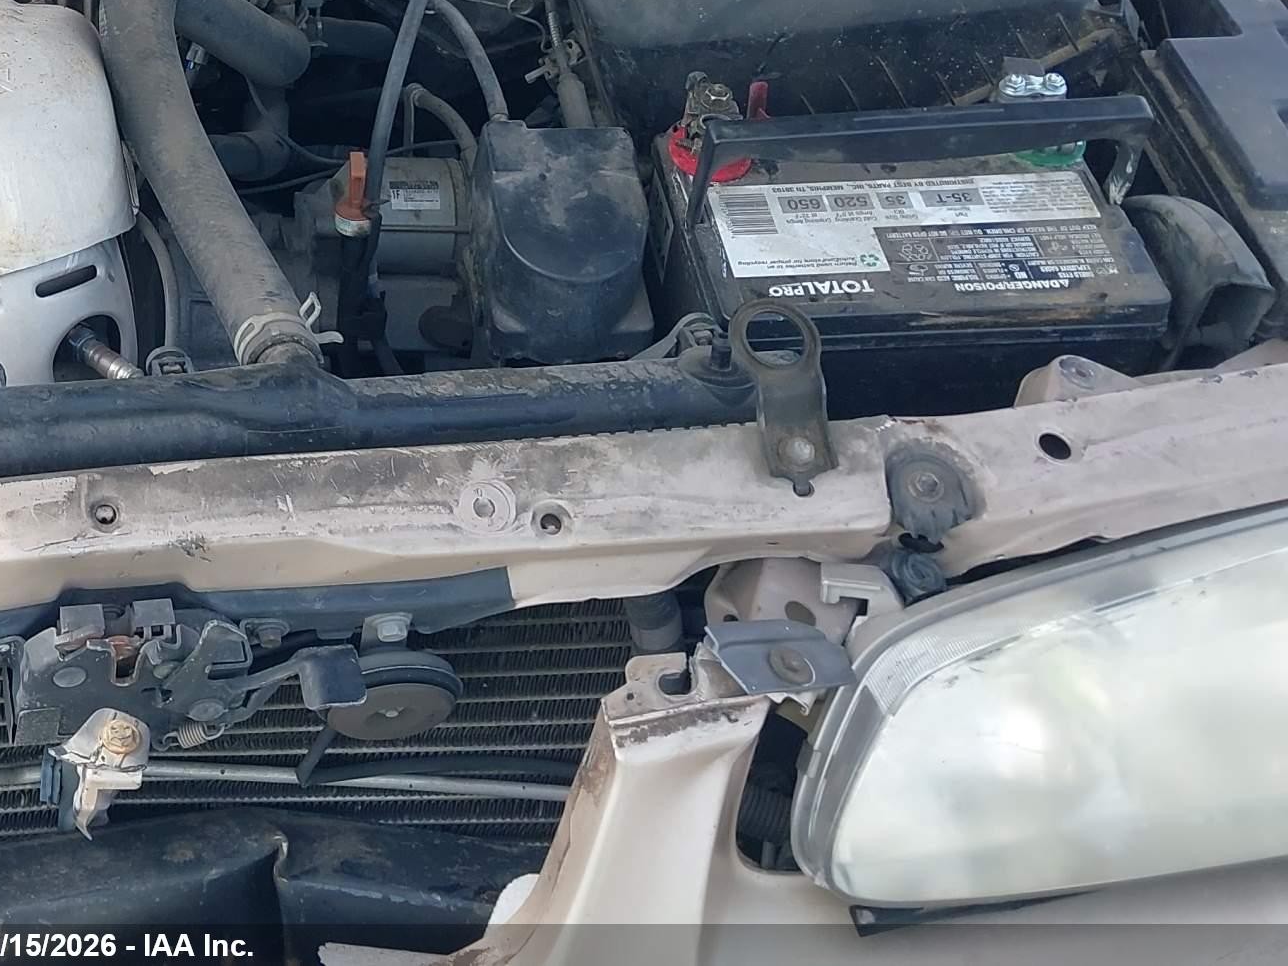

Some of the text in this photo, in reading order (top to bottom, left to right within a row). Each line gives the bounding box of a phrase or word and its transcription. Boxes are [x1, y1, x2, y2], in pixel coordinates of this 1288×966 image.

[925, 178, 974, 187] DISTRIBUTED
[787, 198, 821, 210] 650
[833, 196, 868, 208] 520
[885, 195, 906, 206] 35
[936, 192, 972, 204] 35-T
[768, 279, 875, 297] TOTALPRO
[954, 280, 1061, 292] DANGER/POISON
